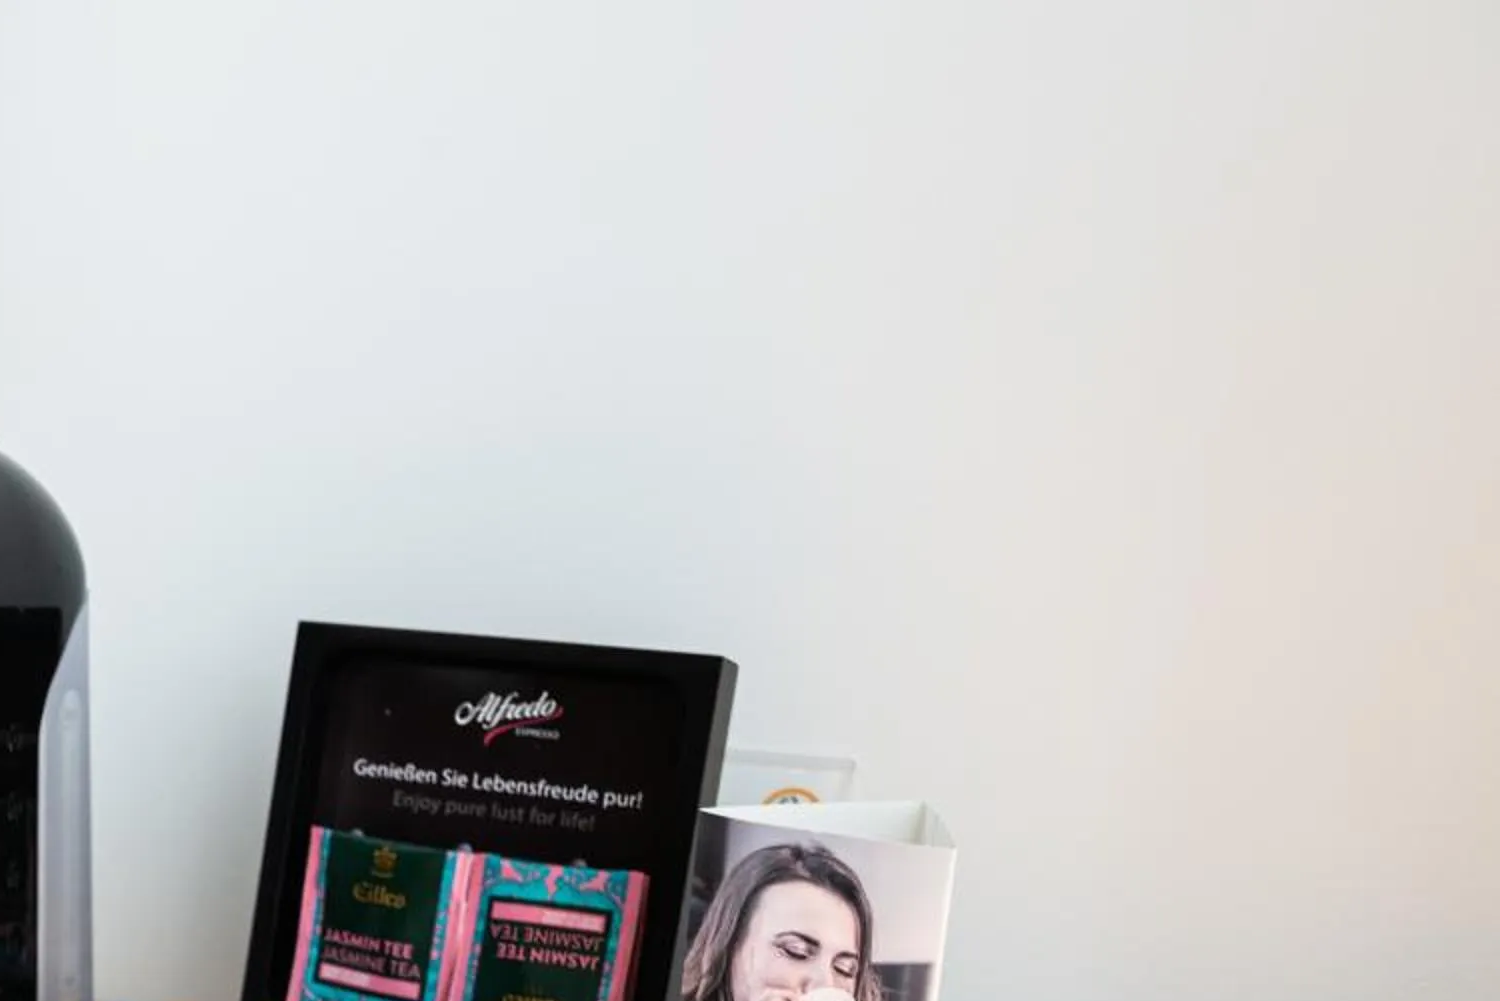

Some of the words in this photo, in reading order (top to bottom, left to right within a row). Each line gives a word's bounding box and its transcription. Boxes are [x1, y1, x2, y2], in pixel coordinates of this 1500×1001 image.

[454, 691, 556, 729] Alfredo
[353, 758, 437, 785] Genießen
[442, 769, 469, 789] Sie
[472, 772, 599, 805] Lebensfreude
[603, 791, 644, 810] pur!
[393, 790, 442, 816] Enjoy
[444, 799, 487, 818] pure
[491, 802, 525, 822] lust
[529, 804, 556, 827] for
[560, 810, 596, 832] life!
[323, 927, 381, 951] JASMIN
[384, 940, 414, 960] TEE
[489, 923, 519, 941] TEA
[523, 926, 604, 952] JASMINE
[321, 945, 386, 974] JASMINE
[390, 958, 422, 979] TEA
[496, 942, 526, 962] TEE
[529, 947, 600, 971] JASMIN
